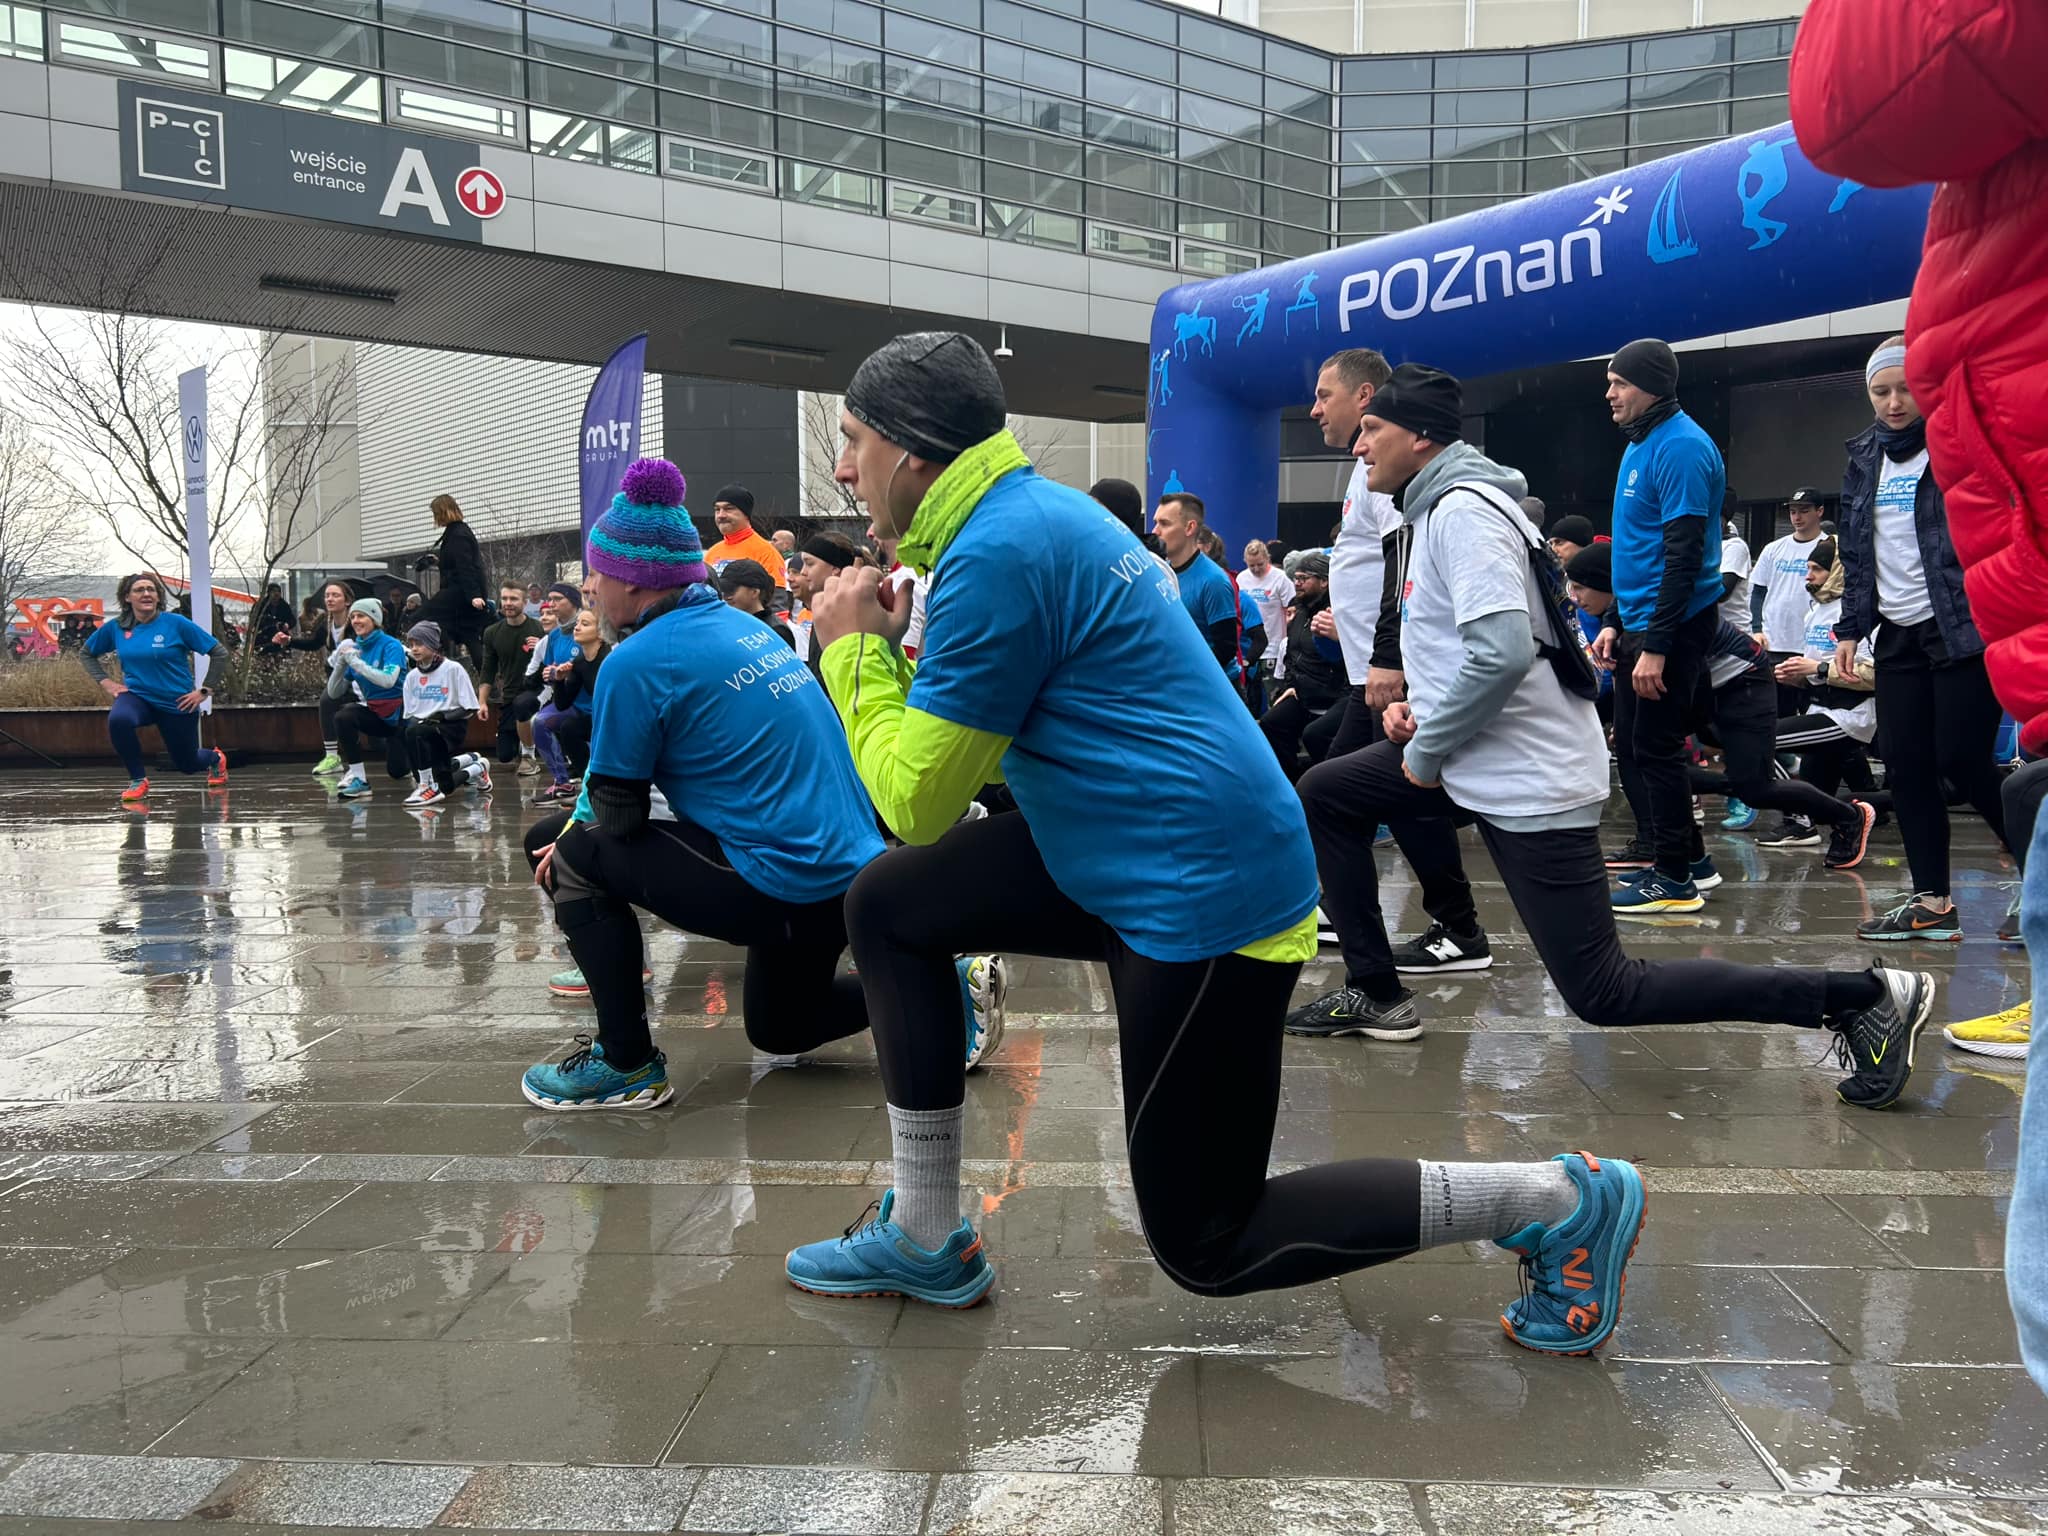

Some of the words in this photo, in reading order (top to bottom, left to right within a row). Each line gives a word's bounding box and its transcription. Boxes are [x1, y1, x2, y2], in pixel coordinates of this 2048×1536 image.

[290, 148, 367, 175] wejście
[293, 171, 366, 193] entrance
[379, 147, 450, 226] A
[737, 630, 774, 651] TEAM
